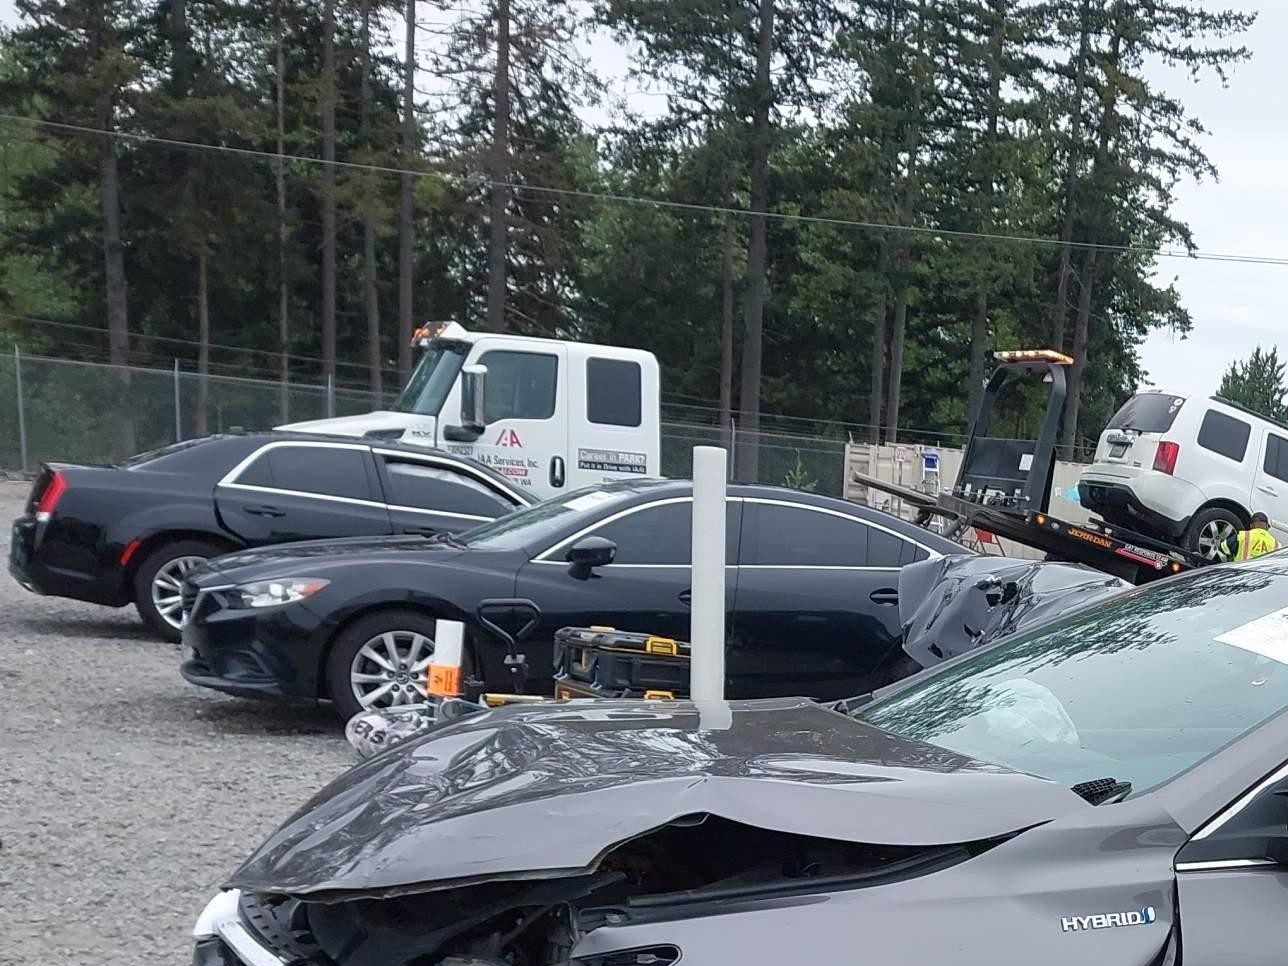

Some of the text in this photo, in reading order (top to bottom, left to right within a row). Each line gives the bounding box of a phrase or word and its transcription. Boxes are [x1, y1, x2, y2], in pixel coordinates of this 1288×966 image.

[618, 453, 645, 464] PARK?
[603, 463, 617, 471] Drive
[1061, 911, 1141, 932] HYBRID
